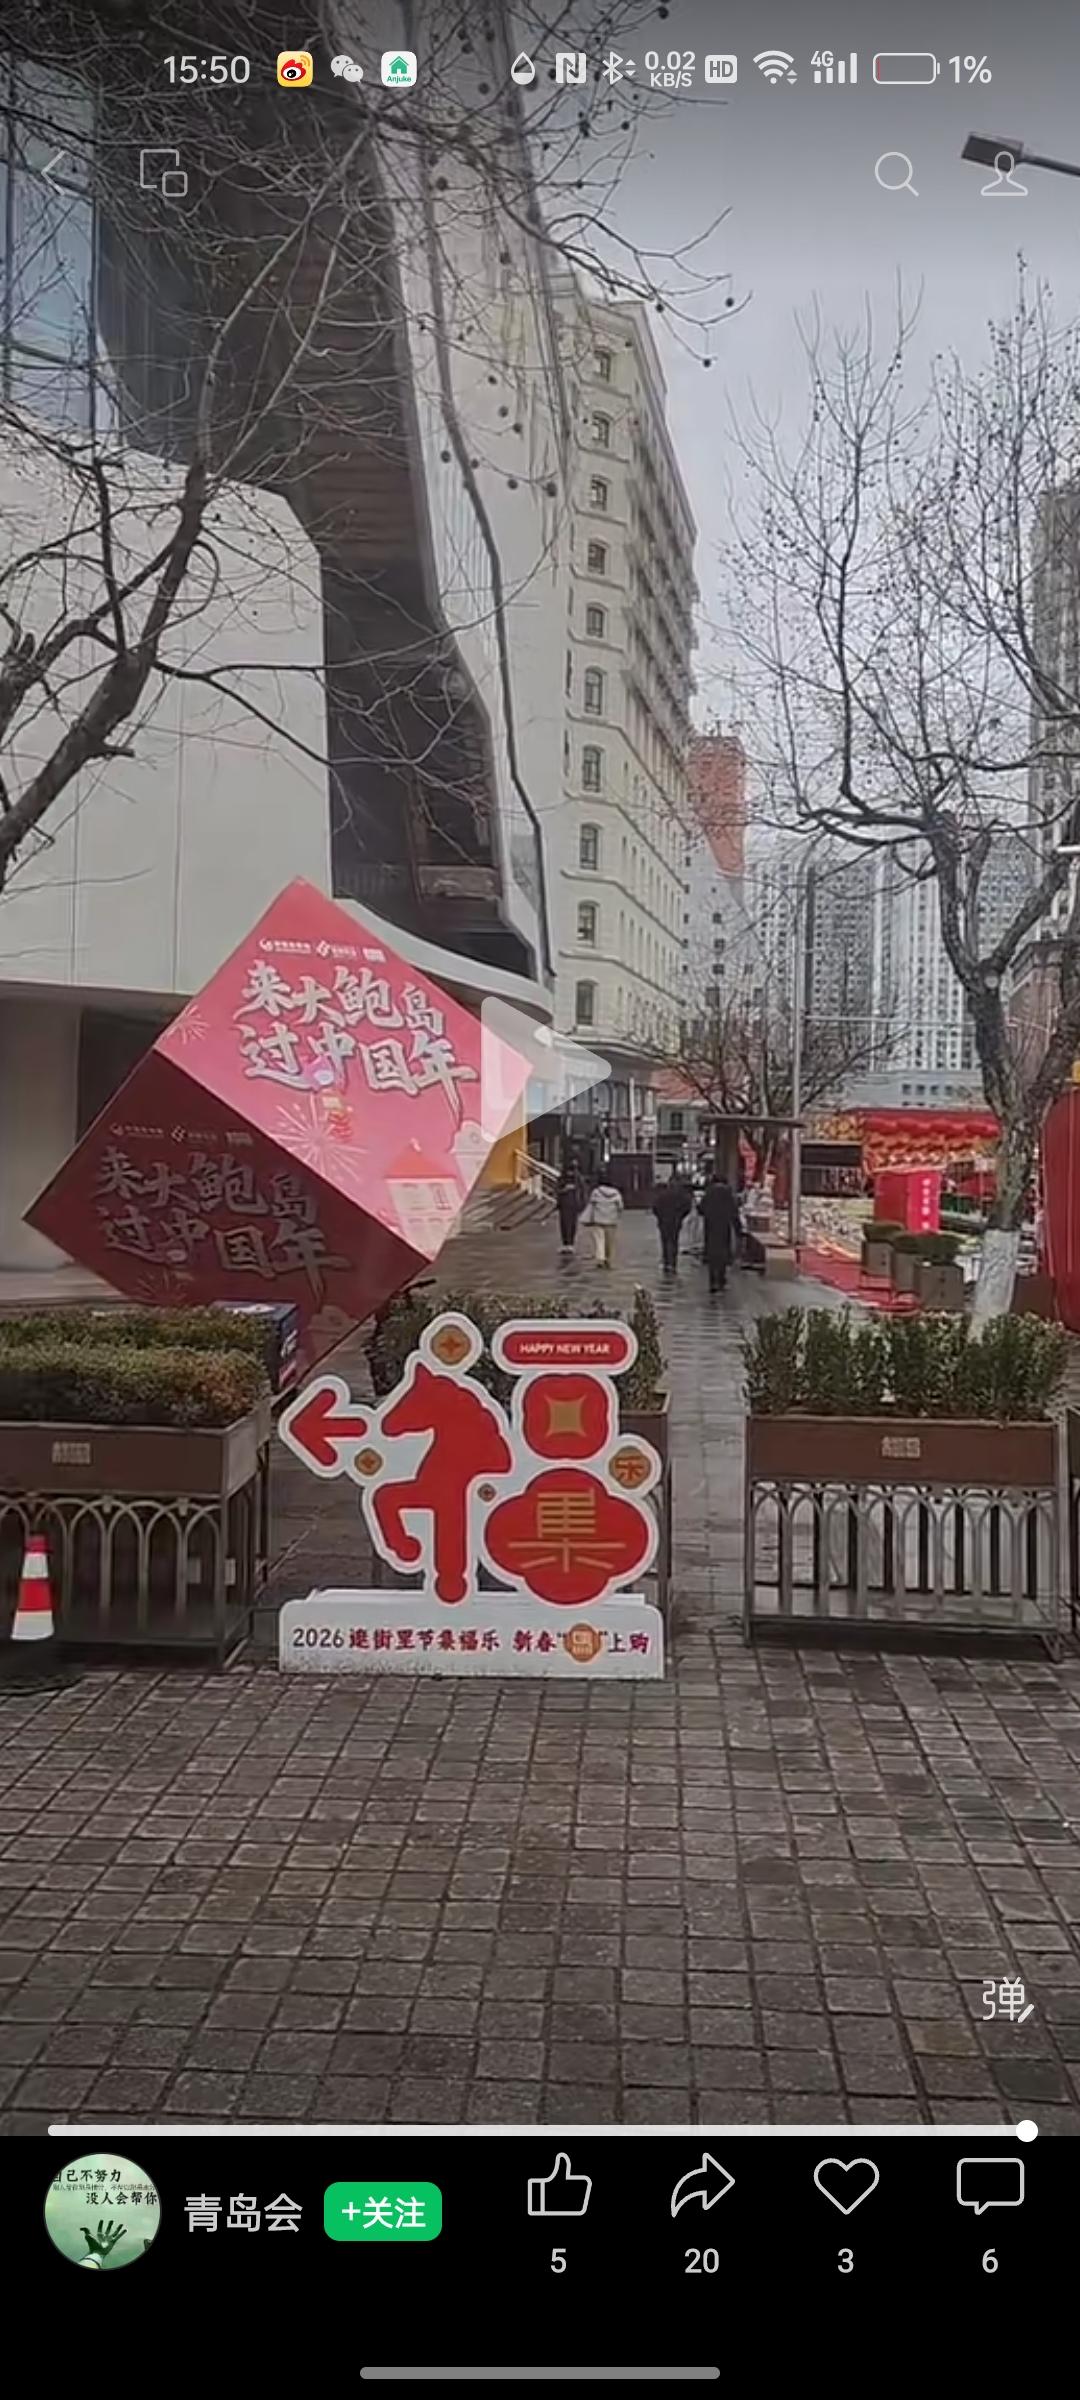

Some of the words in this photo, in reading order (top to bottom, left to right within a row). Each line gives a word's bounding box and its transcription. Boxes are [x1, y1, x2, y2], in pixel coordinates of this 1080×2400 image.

[233, 959, 445, 1037] 来大鲍岛
[232, 1021, 480, 1130] 过中国年
[94, 1145, 319, 1226] 来大鲍岛
[97, 1203, 352, 1308] 过中国年
[520, 1343, 554, 1355] HAPPY
[556, 1343, 581, 1355] NEW
[583, 1343, 610, 1355] YEAR
[508, 1487, 627, 1574] 集
